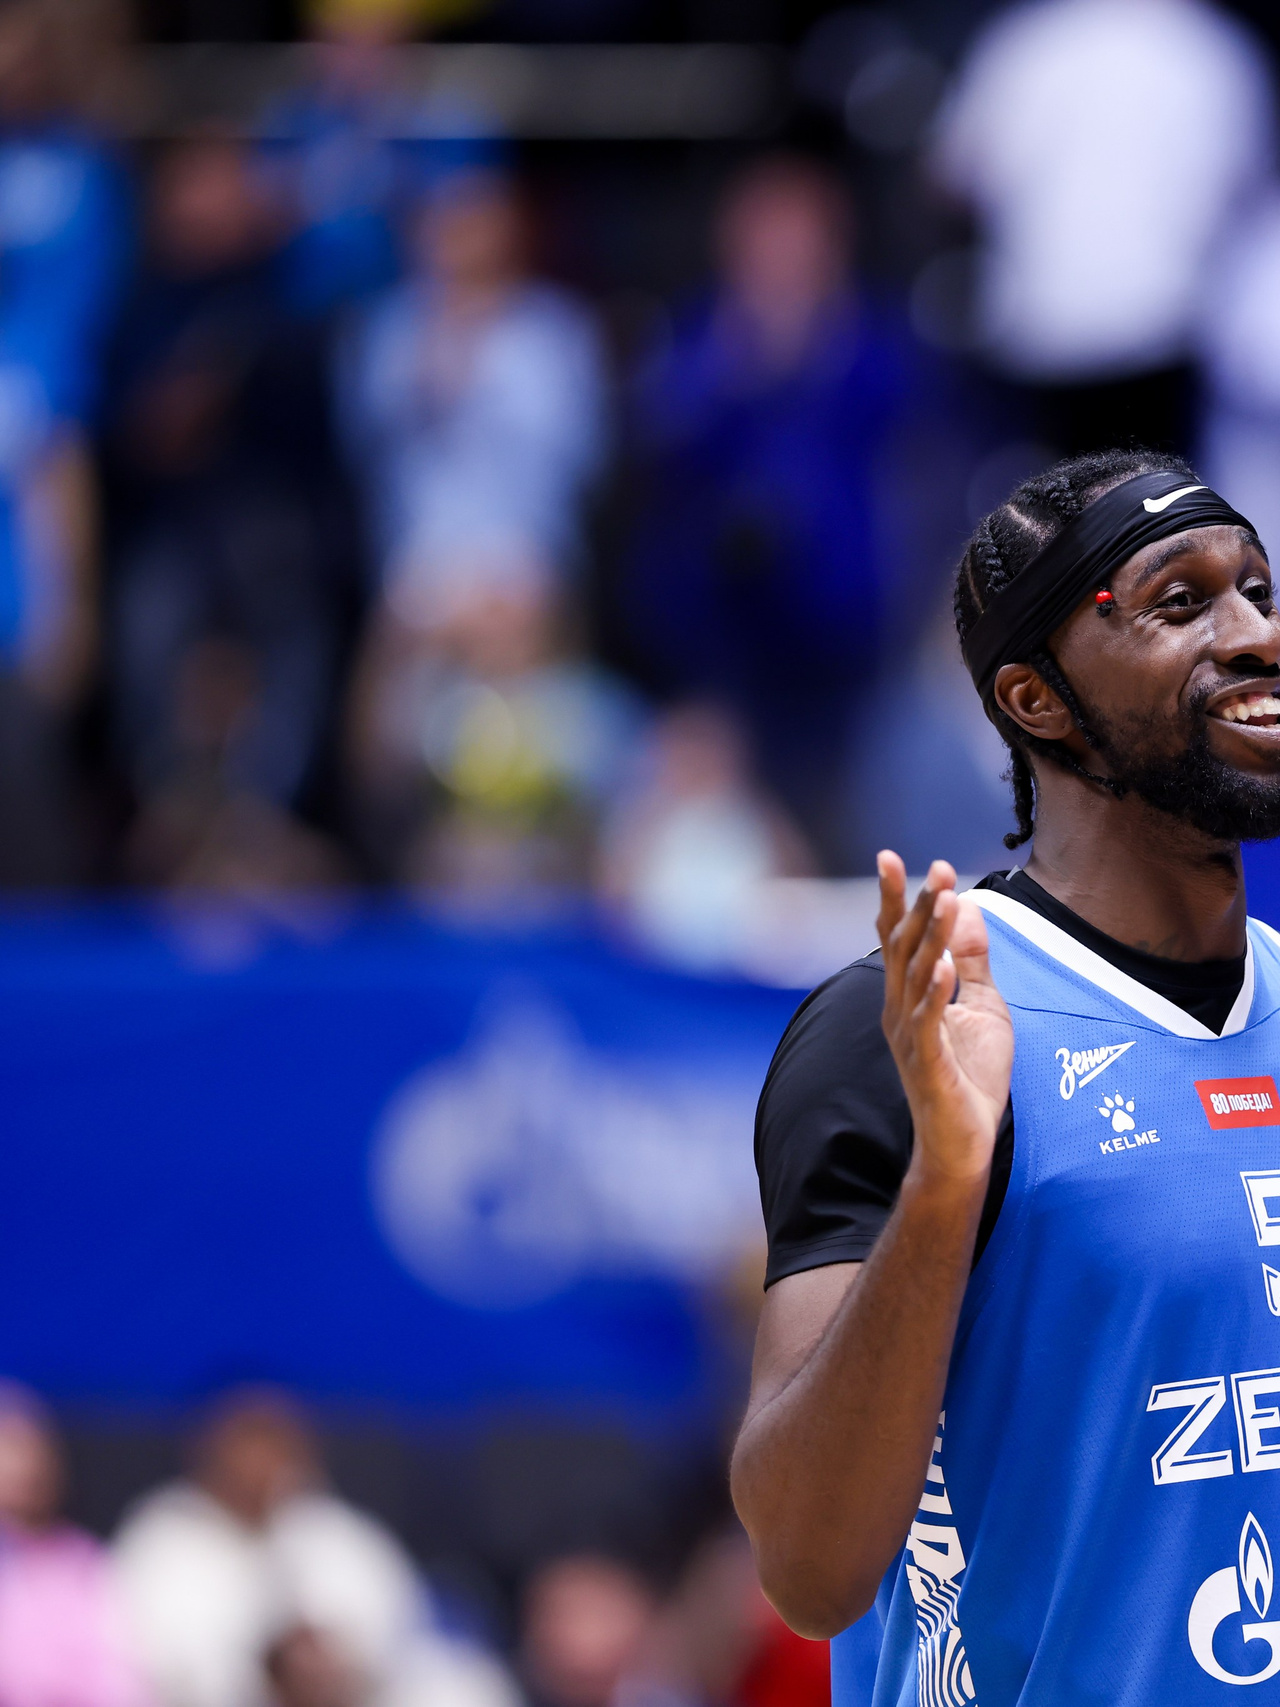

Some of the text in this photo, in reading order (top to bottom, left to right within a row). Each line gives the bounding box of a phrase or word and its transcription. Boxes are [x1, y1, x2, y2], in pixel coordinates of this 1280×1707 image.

[1210, 1092, 1273, 1115] 80 ПОБЕДА!
[1099, 1129, 1161, 1155] KELME
